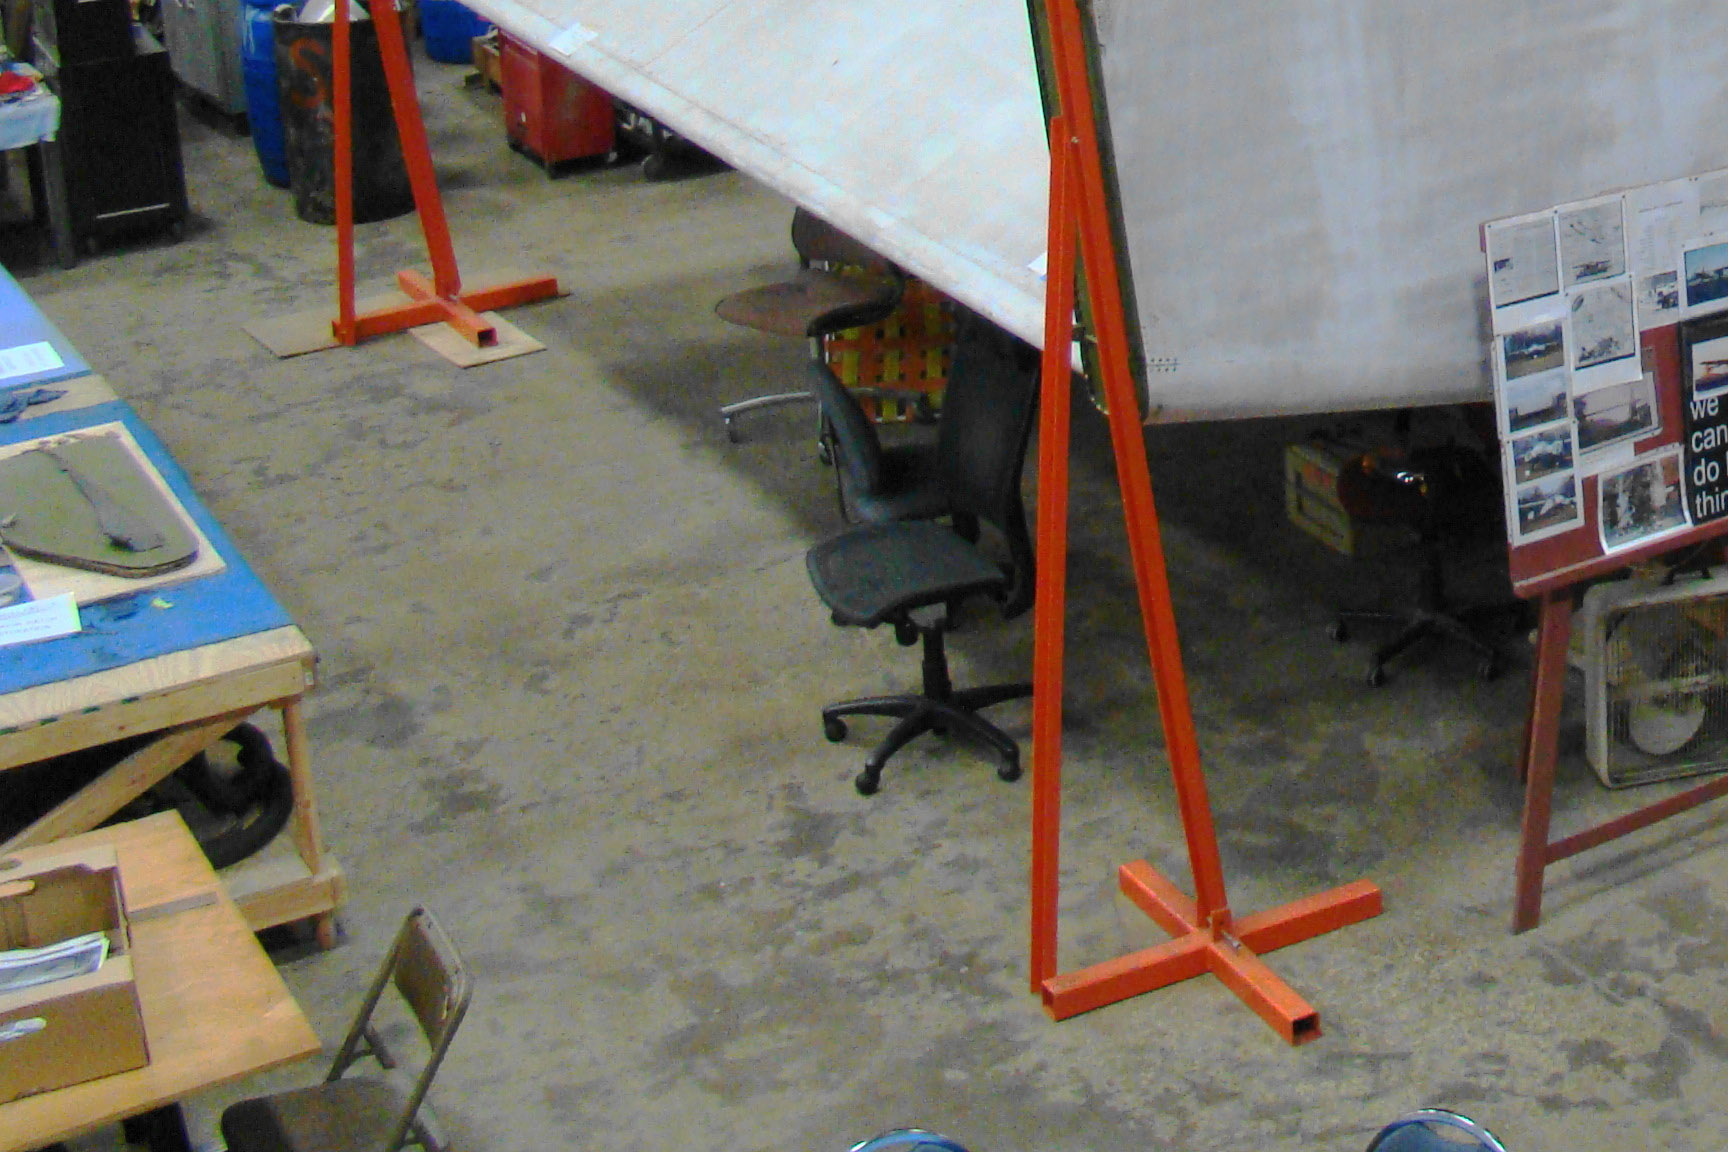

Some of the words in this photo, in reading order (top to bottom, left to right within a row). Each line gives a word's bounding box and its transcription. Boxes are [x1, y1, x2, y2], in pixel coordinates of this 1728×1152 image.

[1690, 397, 1719, 421] we
[1692, 424, 1728, 453] can
[1693, 458, 1720, 486] do
